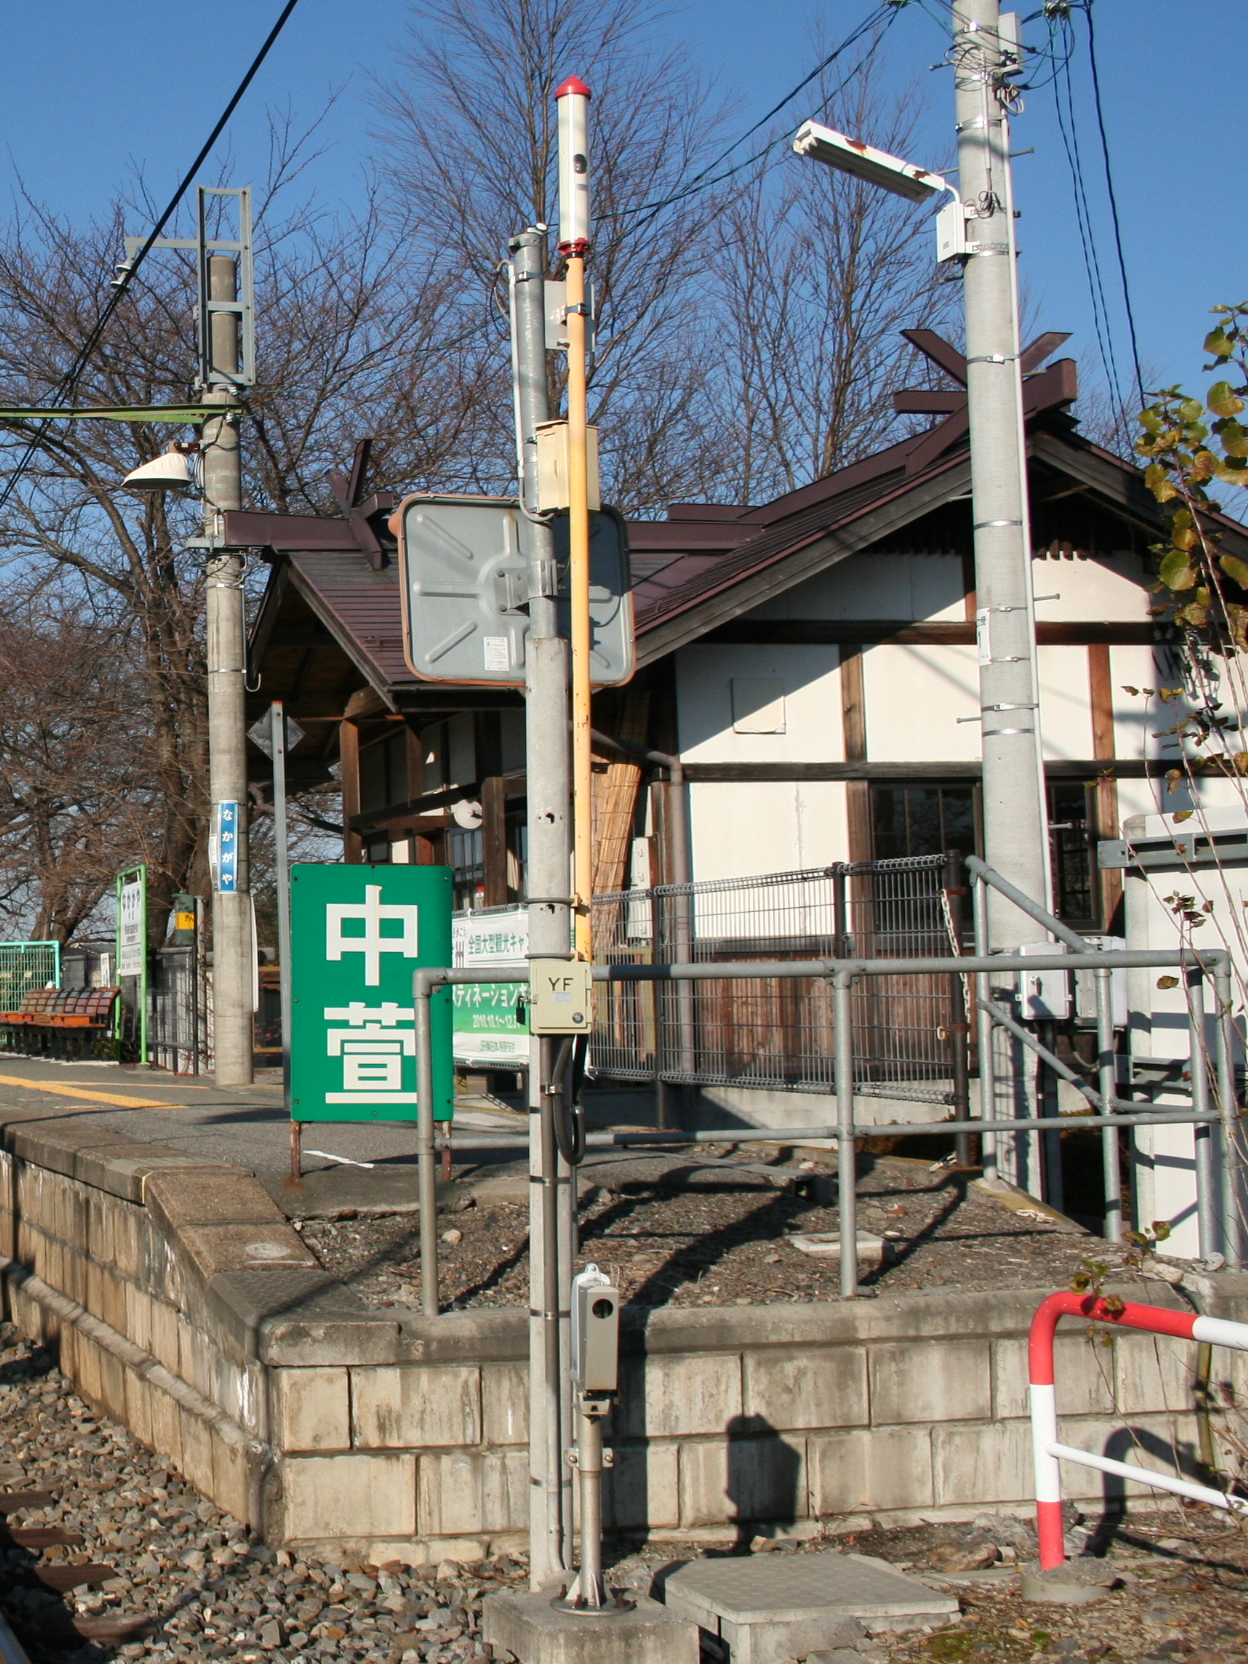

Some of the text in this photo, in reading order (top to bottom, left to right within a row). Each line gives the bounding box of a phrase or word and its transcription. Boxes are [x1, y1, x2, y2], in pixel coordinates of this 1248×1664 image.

[221, 809, 235, 886] なかがや
[323, 884, 418, 1105] 中萱
[548, 977, 574, 992] YF
